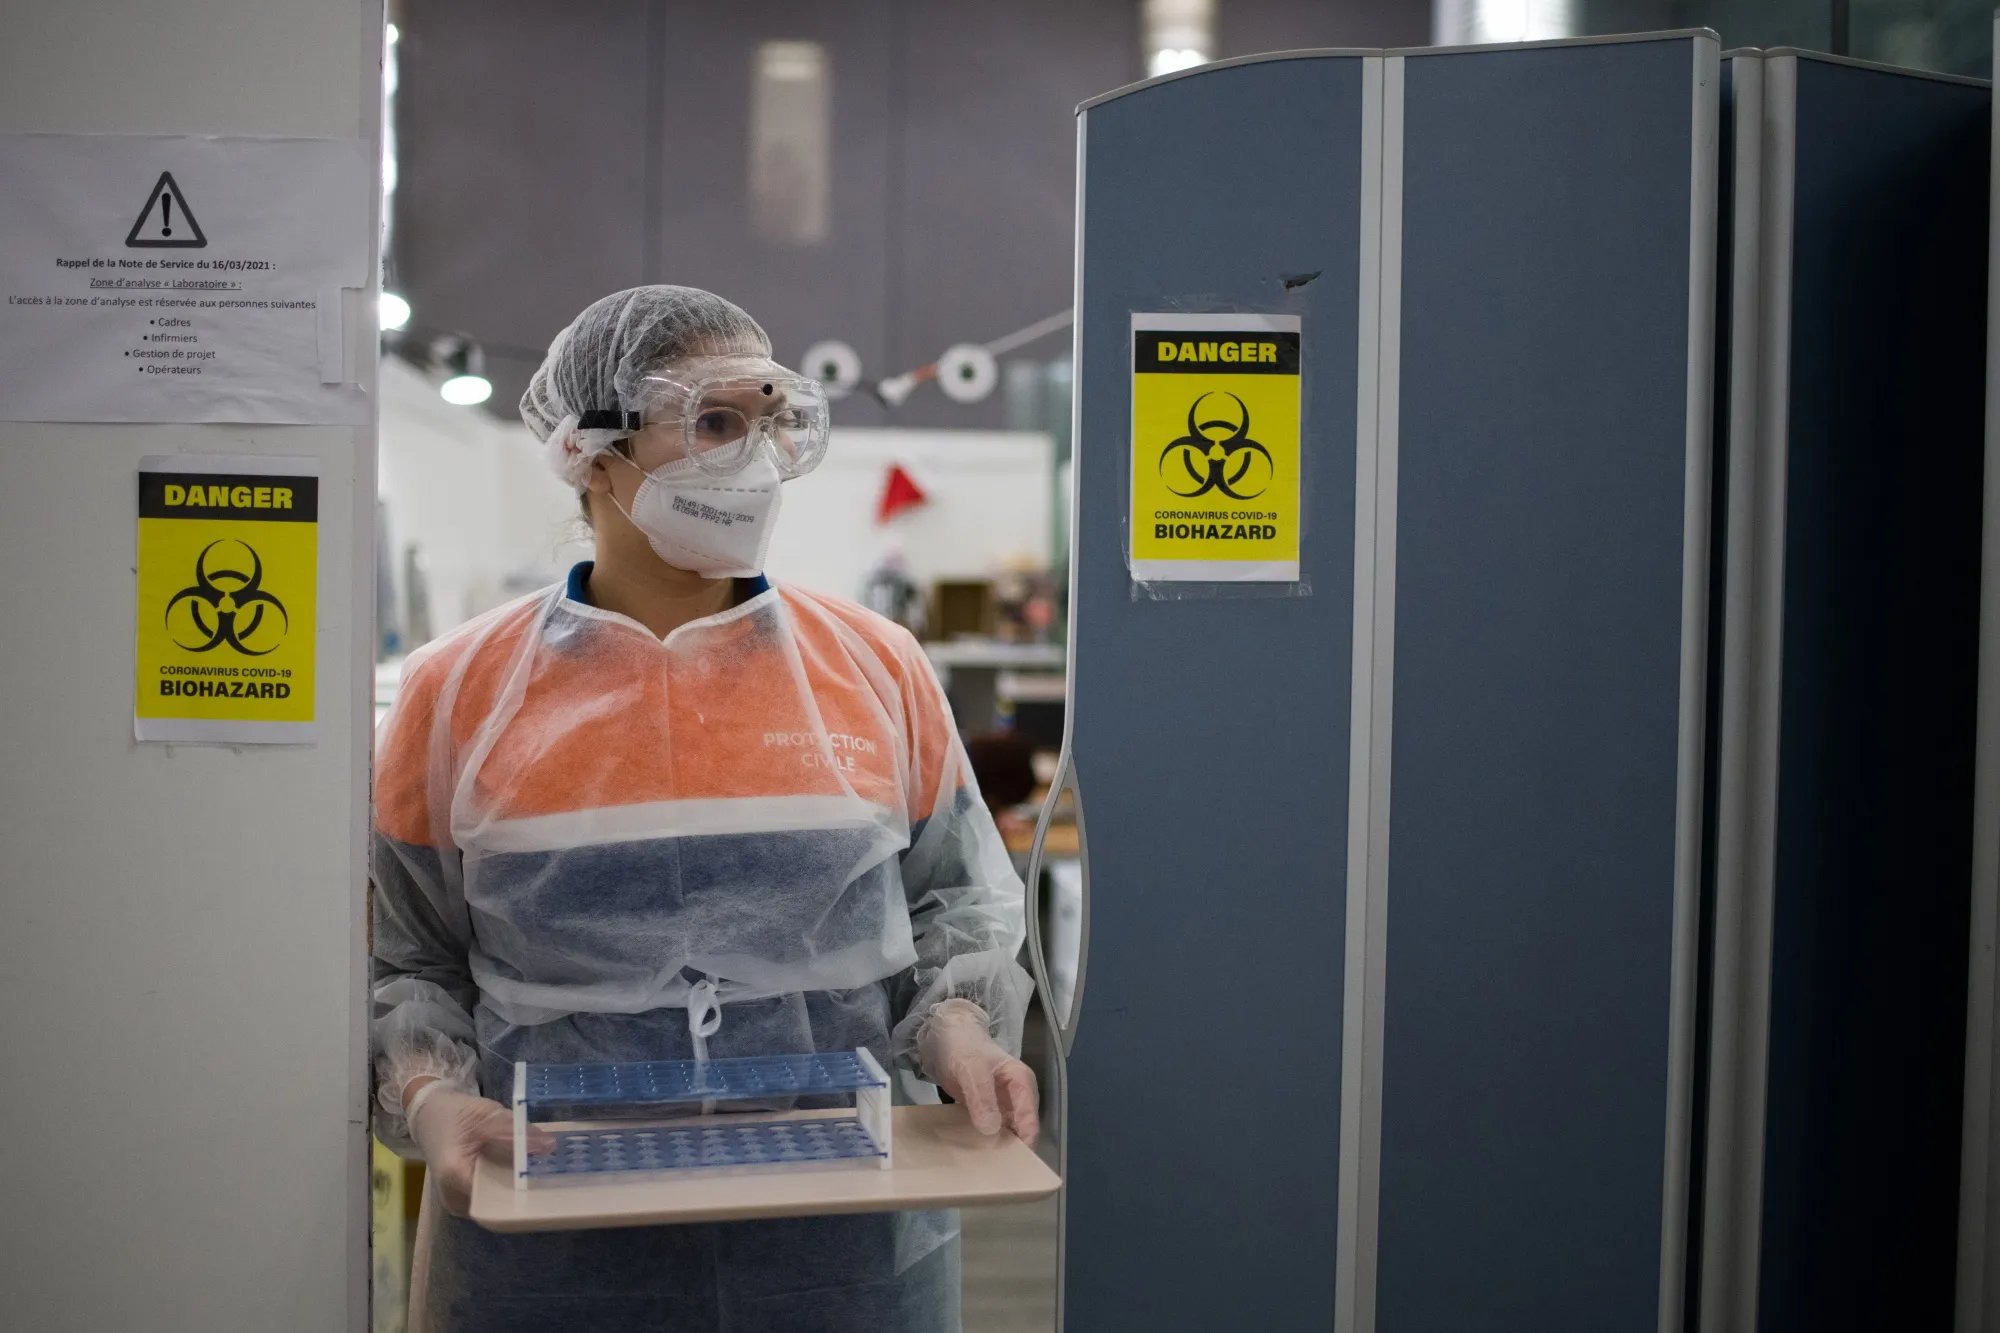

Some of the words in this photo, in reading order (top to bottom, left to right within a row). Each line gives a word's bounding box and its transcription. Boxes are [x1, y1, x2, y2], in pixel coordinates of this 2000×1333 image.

[56, 258, 90, 270] Rappel
[92, 259, 104, 268] de
[107, 259, 116, 268] la
[119, 259, 143, 269] Note
[146, 259, 158, 269] de
[160, 260, 194, 269] Service
[197, 260, 209, 269] du
[212, 260, 269, 271] 16/03/2021
[90, 278, 114, 288] Zone
[173, 279, 228, 289] Laboratoire
[46, 296, 52, 305] à
[54, 296, 62, 306] la
[65, 298, 88, 306] zone
[138, 298, 153, 307] est
[155, 297, 197, 308] réservée
[200, 300, 216, 308] aux
[219, 300, 268, 310] personnes
[271, 299, 317, 309] suivantes
[158, 317, 191, 327] Cadres
[151, 333, 198, 343] Infirmiers
[133, 349, 170, 358] Gestion
[172, 349, 184, 359] de
[187, 349, 216, 360] projet
[1157, 341, 1277, 363] DANGER
[147, 364, 202, 375] Opérateurs
[163, 484, 293, 509] DANGER
[700, 512, 720, 524] FFP2
[722, 518, 733, 527] NR
[1155, 511, 1229, 520] CORONAVIRUS
[1231, 511, 1278, 520] COVID-19
[1155, 524, 1277, 540] BIOHAZARD
[160, 665, 239, 677] CORONAVIRUS
[241, 667, 292, 678] COVID-19
[160, 680, 291, 699] BIOHAZARD
[763, 732, 877, 755] PROTCTION
